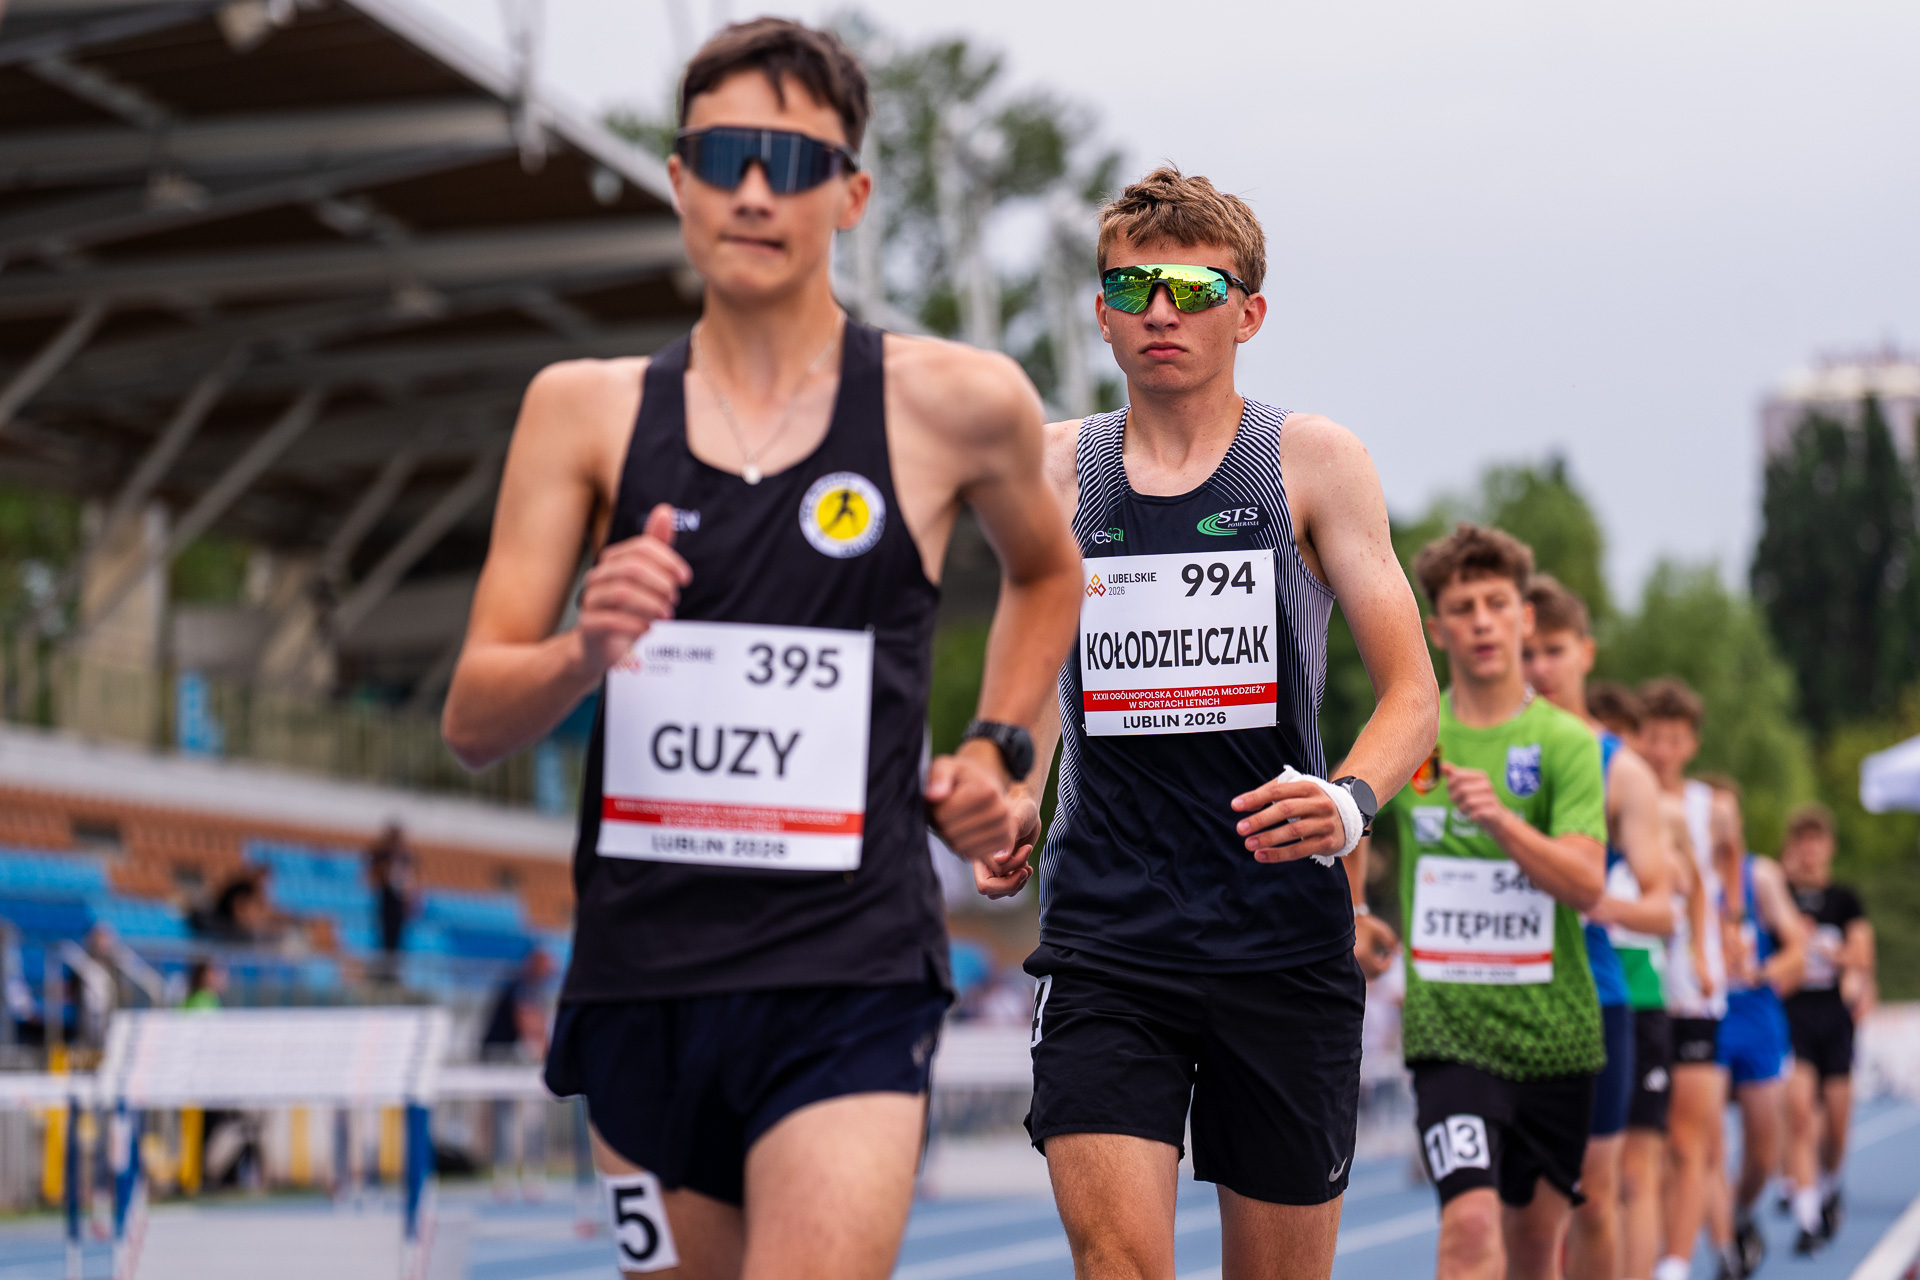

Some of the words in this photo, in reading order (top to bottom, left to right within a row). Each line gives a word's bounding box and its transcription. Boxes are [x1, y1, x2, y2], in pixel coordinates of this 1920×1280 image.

[1217, 507, 1258, 523] STS
[1108, 572, 1157, 584] LUBELSKIE
[1108, 586, 1125, 596] 2026
[1181, 561, 1256, 597] 994
[747, 643, 840, 689] 395
[1086, 625, 1270, 671] KOŁODZIEJCZAK
[1092, 693, 1109, 701] XXXII
[1109, 691, 1172, 700] OGÓLNOPOLSKA
[1173, 688, 1220, 698] OLIMPIADA
[1221, 685, 1266, 696] MŁODZIEŻY
[1129, 701, 1137, 709] W
[1138, 699, 1184, 709] SPORTACH
[1185, 698, 1220, 707] LETNICH
[1123, 715, 1180, 729] LUBLIN
[1184, 711, 1227, 727] 2026
[650, 723, 801, 777] GUZY
[1424, 905, 1542, 945] STĘPIEŃ
[1427, 1124, 1480, 1169] 13
[614, 1187, 658, 1261] 5
